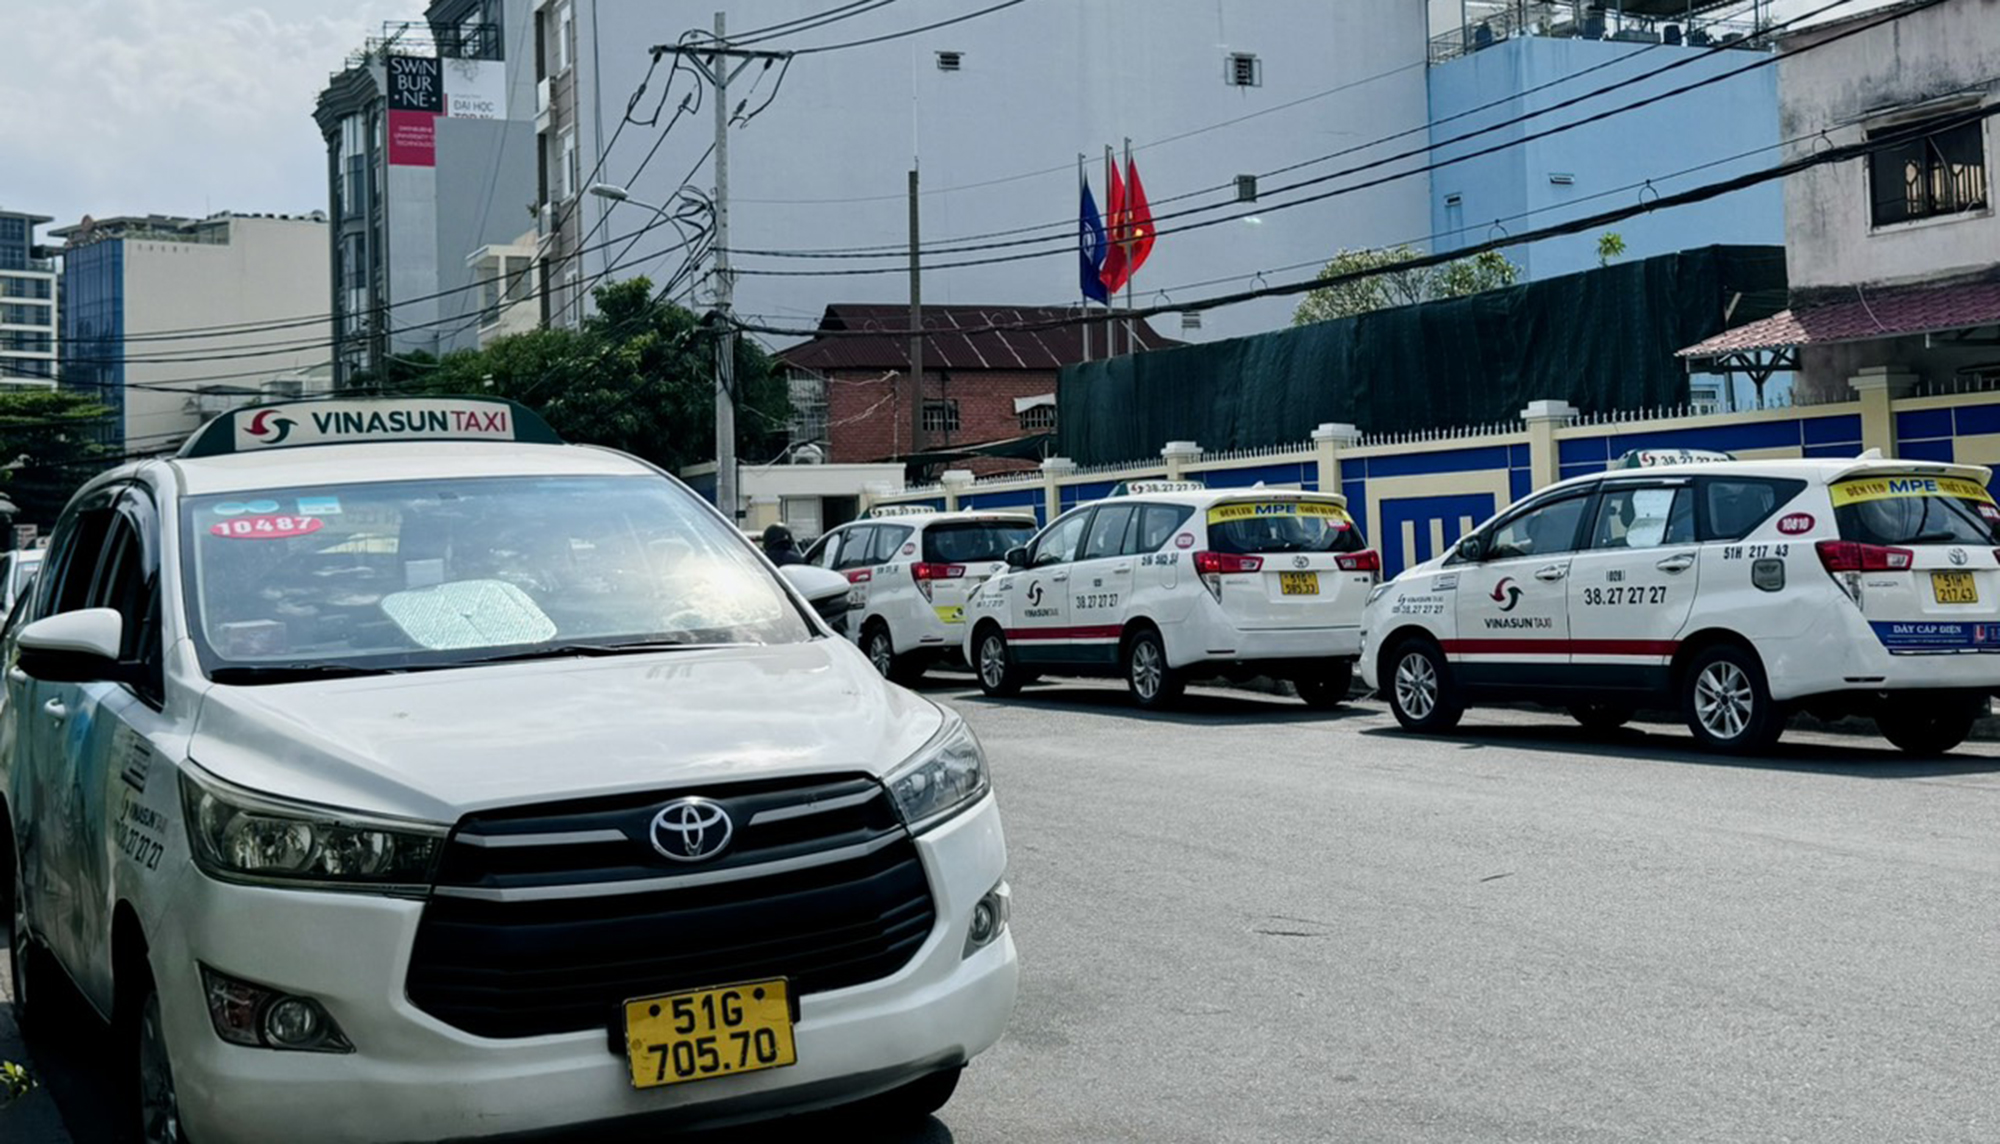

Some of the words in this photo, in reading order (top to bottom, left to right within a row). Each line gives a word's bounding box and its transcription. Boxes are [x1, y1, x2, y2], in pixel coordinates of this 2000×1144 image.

[397, 74, 432, 91] BUR
[402, 91, 428, 107] NE
[1889, 479, 1938, 493] MPE
[1255, 504, 1297, 514] MPE
[216, 516, 312, 535] 10487
[1724, 547, 1743, 560] 51H
[1749, 545, 1768, 558] 217
[1775, 544, 1789, 557] 43
[1943, 573, 1963, 587] 51H
[1628, 587, 1645, 604] 27
[1650, 586, 1667, 604] 27
[672, 991, 743, 1035] 51G
[647, 1027, 777, 1081] 705.70
